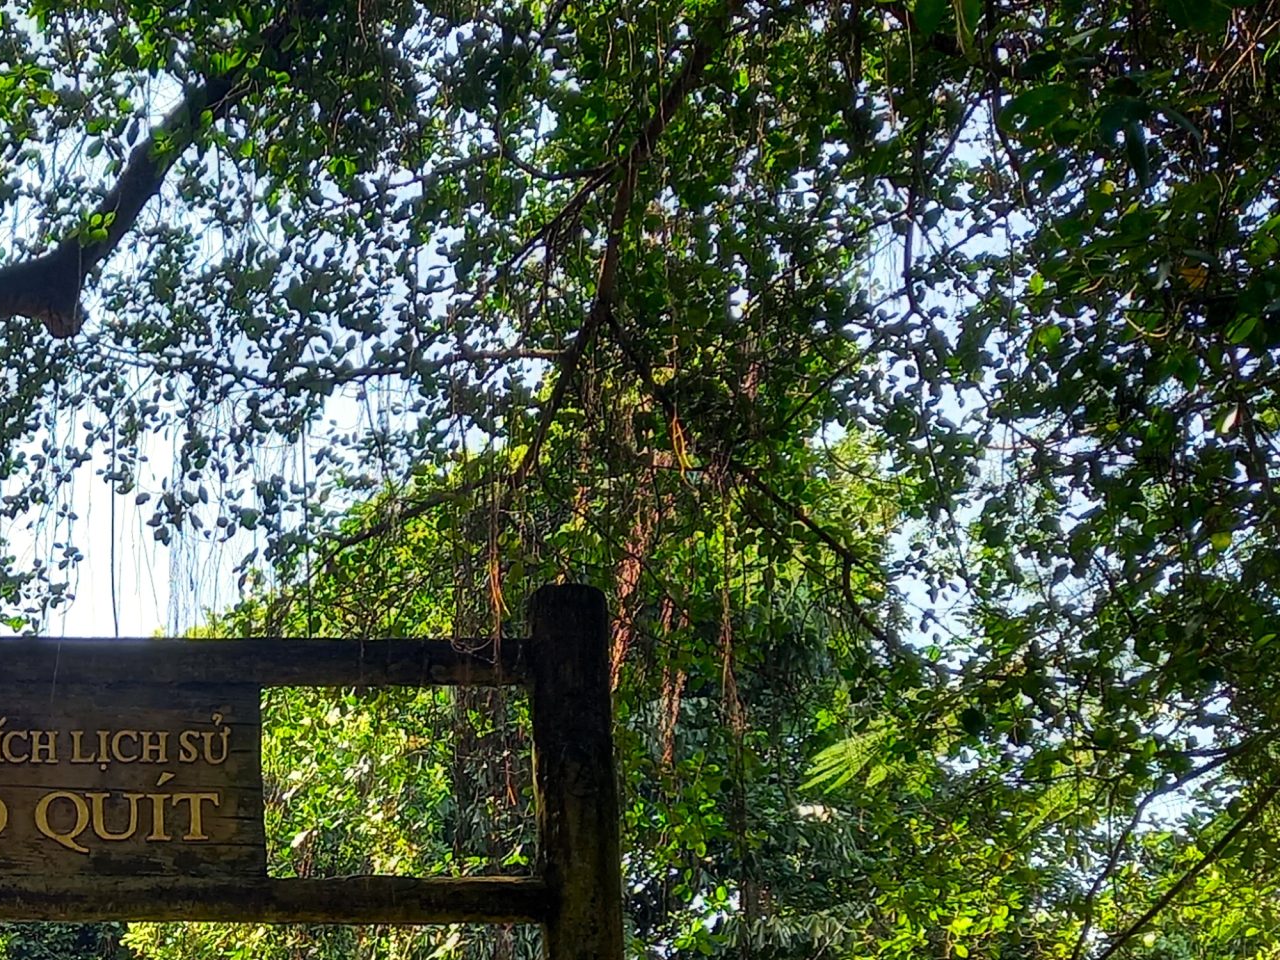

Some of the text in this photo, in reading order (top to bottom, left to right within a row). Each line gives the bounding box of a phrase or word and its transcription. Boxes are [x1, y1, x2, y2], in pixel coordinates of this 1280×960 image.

[70, 729, 169, 770] LỊCH
[179, 712, 232, 765] SỬ
[34, 772, 220, 854] QUÍT
